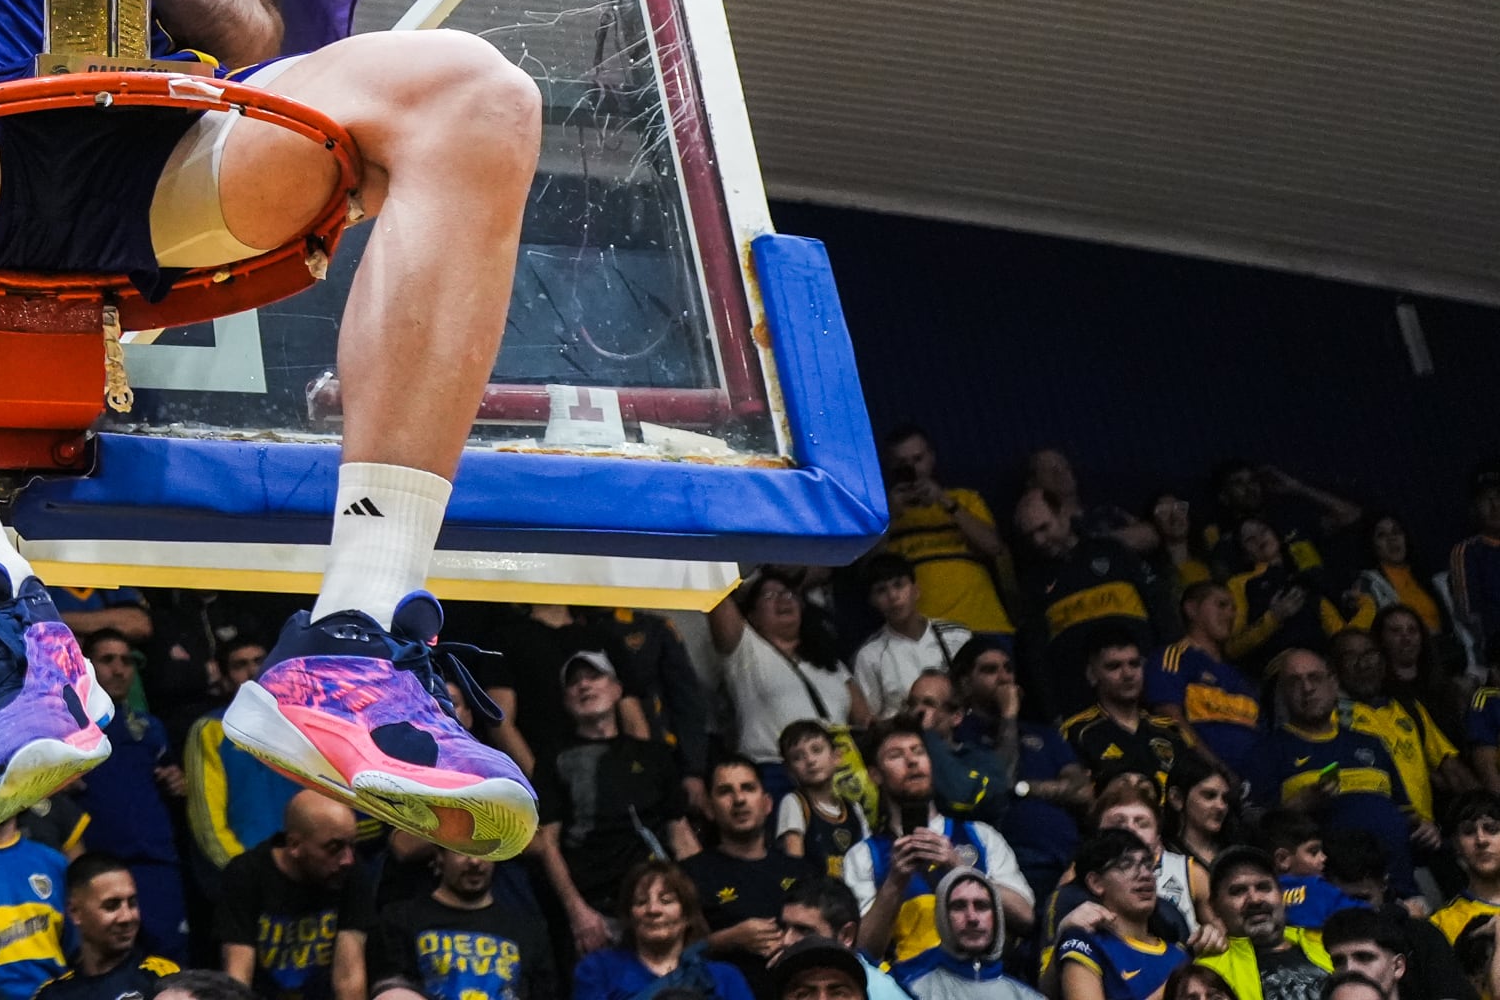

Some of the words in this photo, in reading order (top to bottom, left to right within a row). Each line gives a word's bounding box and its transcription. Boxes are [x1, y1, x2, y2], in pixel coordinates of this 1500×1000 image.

[88, 64, 168, 73] CAMPEÓ
[417, 932, 520, 963] DIEGO
[431, 952, 514, 981] VIVE
